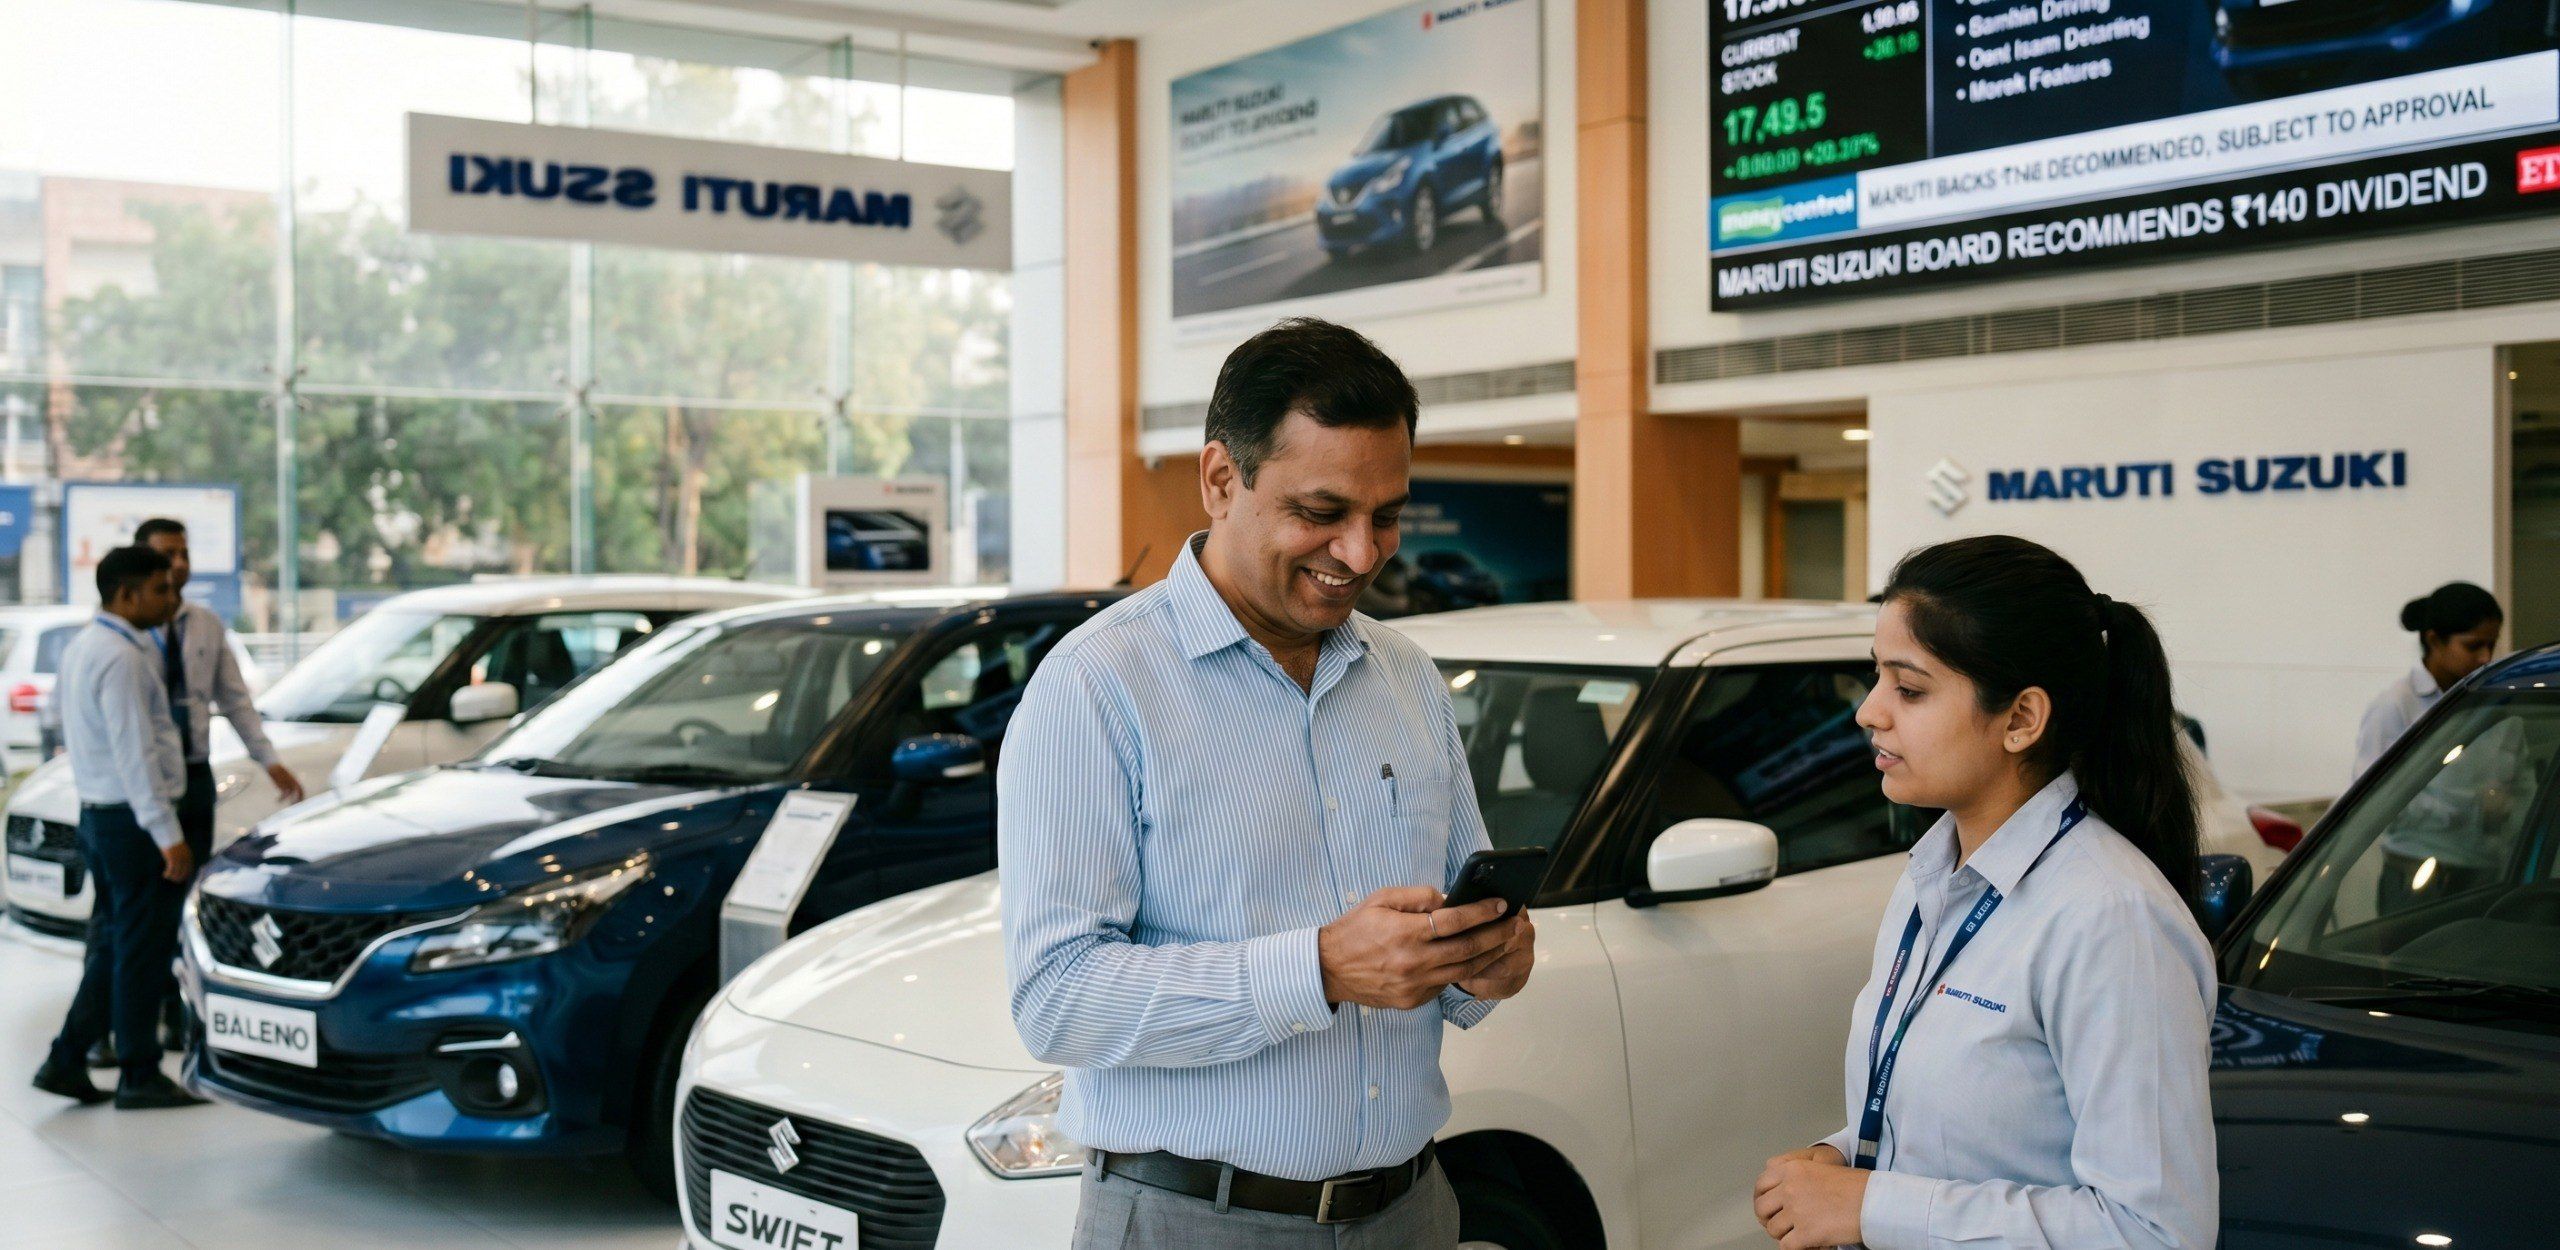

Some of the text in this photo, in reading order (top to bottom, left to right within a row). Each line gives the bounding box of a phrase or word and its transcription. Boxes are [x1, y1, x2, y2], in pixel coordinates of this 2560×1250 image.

[1721, 28, 1800, 67] CURRENT
[1721, 61, 1778, 95] STOCK
[2029, 58, 2112, 91] Features
[1937, 168, 1997, 195] BACKS
[2218, 114, 2317, 152] SUBJECT
[2325, 107, 2357, 133] TO
[2363, 87, 2495, 127] APPROVAL
[1718, 161, 2489, 298] MARUTI SUZUKI BOARD RECOMMENDS ₹140 DIVIDEND
[1987, 450, 2408, 501] MARUTI SUZUKI
[213, 1012, 309, 1051] BALENO
[726, 1203, 844, 1250] SWIFT
